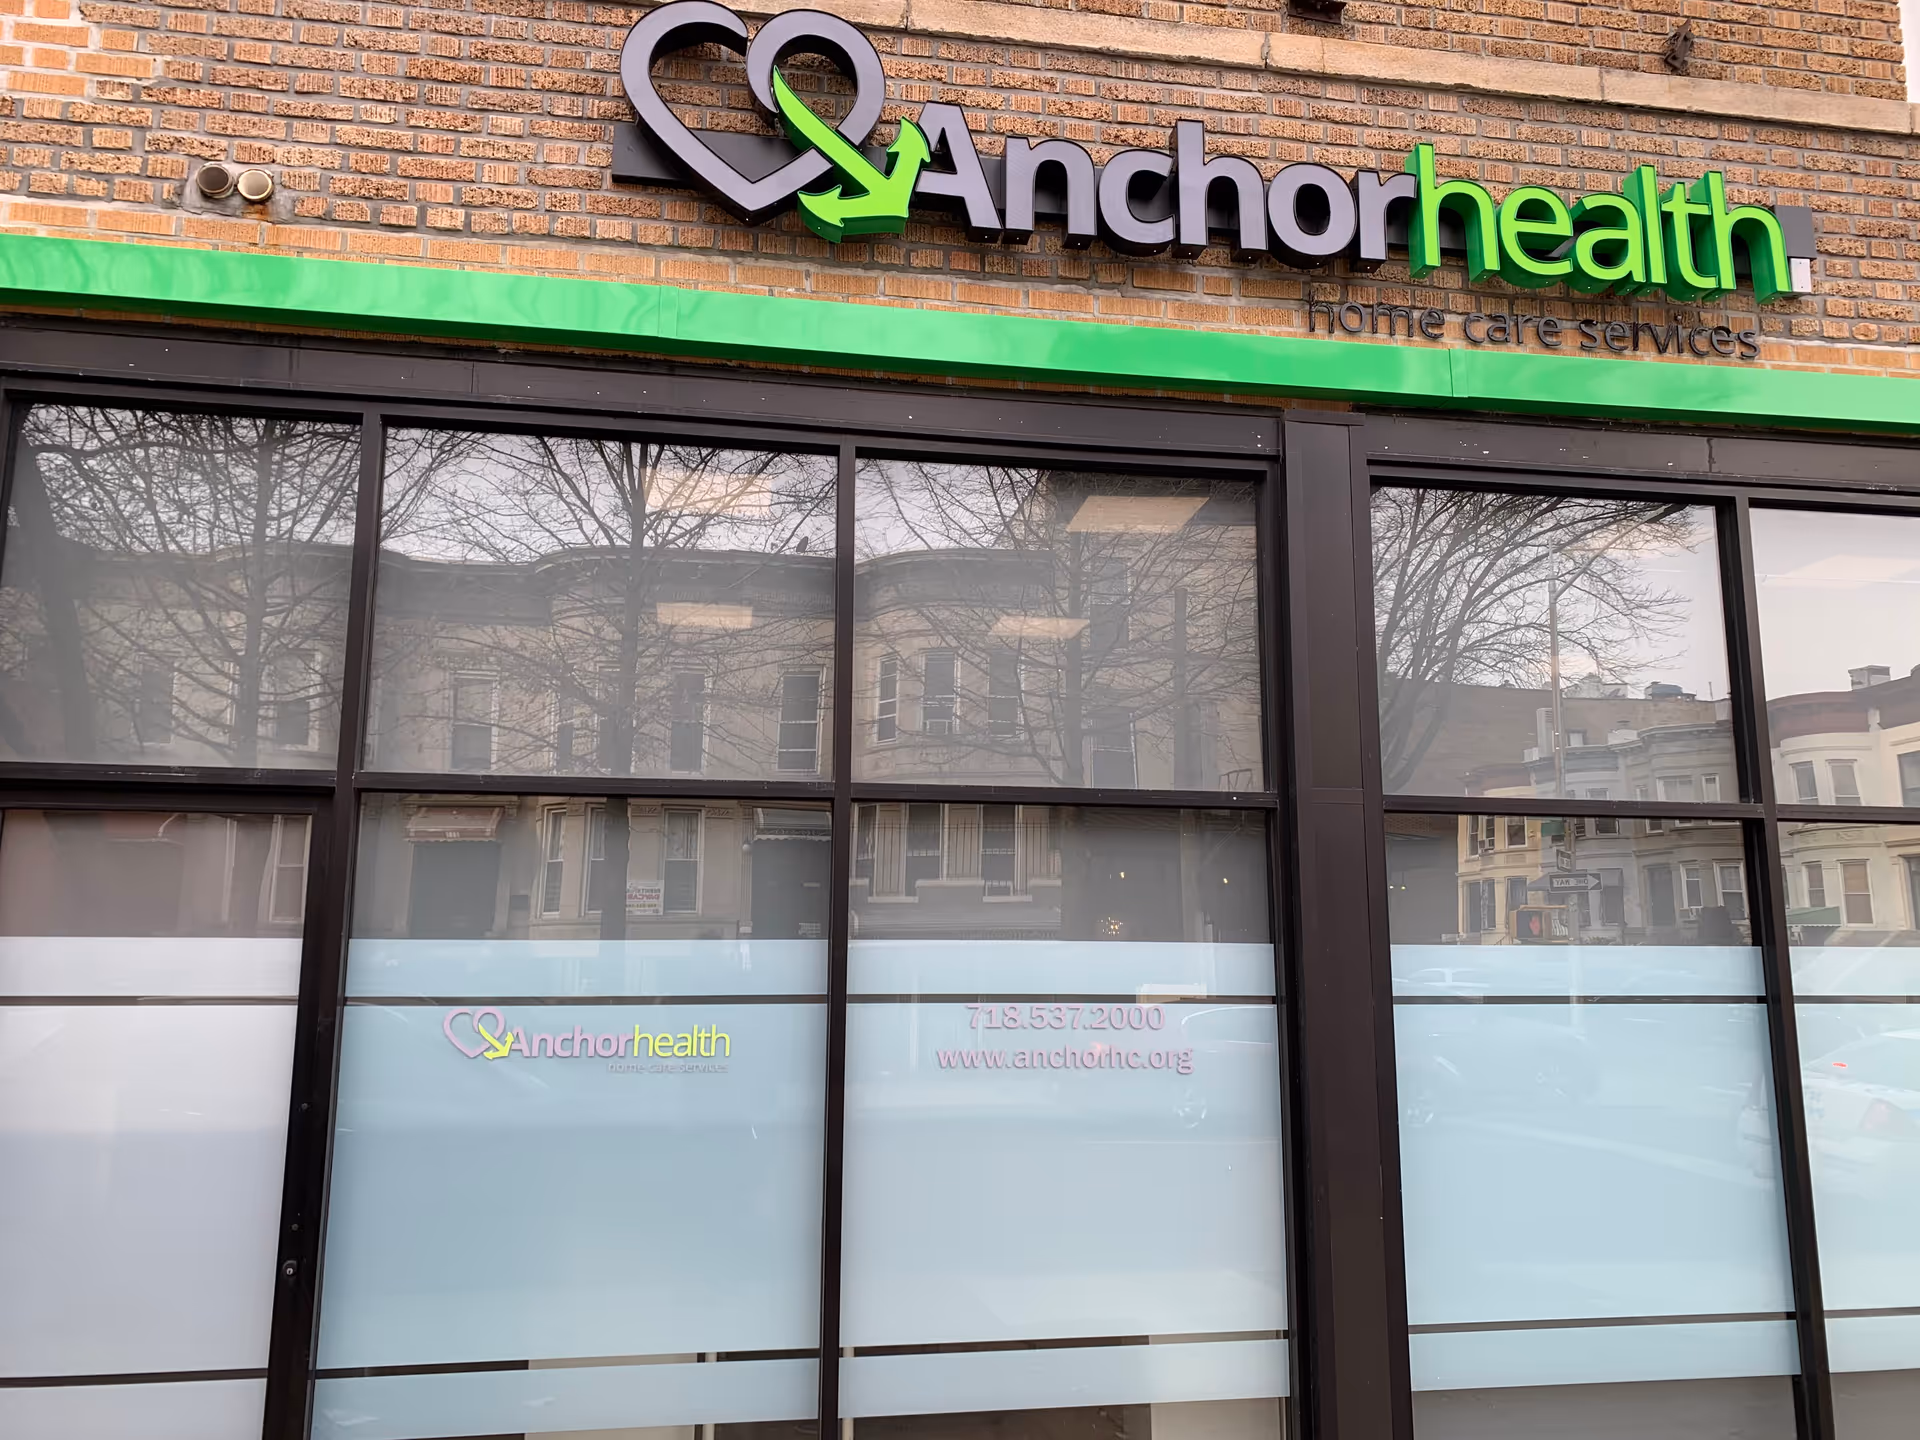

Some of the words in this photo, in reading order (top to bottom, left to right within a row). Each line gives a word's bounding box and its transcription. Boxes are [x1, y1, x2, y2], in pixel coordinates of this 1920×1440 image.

[1308, 289, 1445, 339] home
[1464, 310, 1563, 347] care
[1580, 314, 1761, 358] services
[966, 1004, 1166, 1030] 718.537.2000
[608, 1063, 645, 1073] home
[649, 1063, 676, 1073] care
[679, 1063, 729, 1073] services
[937, 1046, 1194, 1074] www.anchorhc.org
